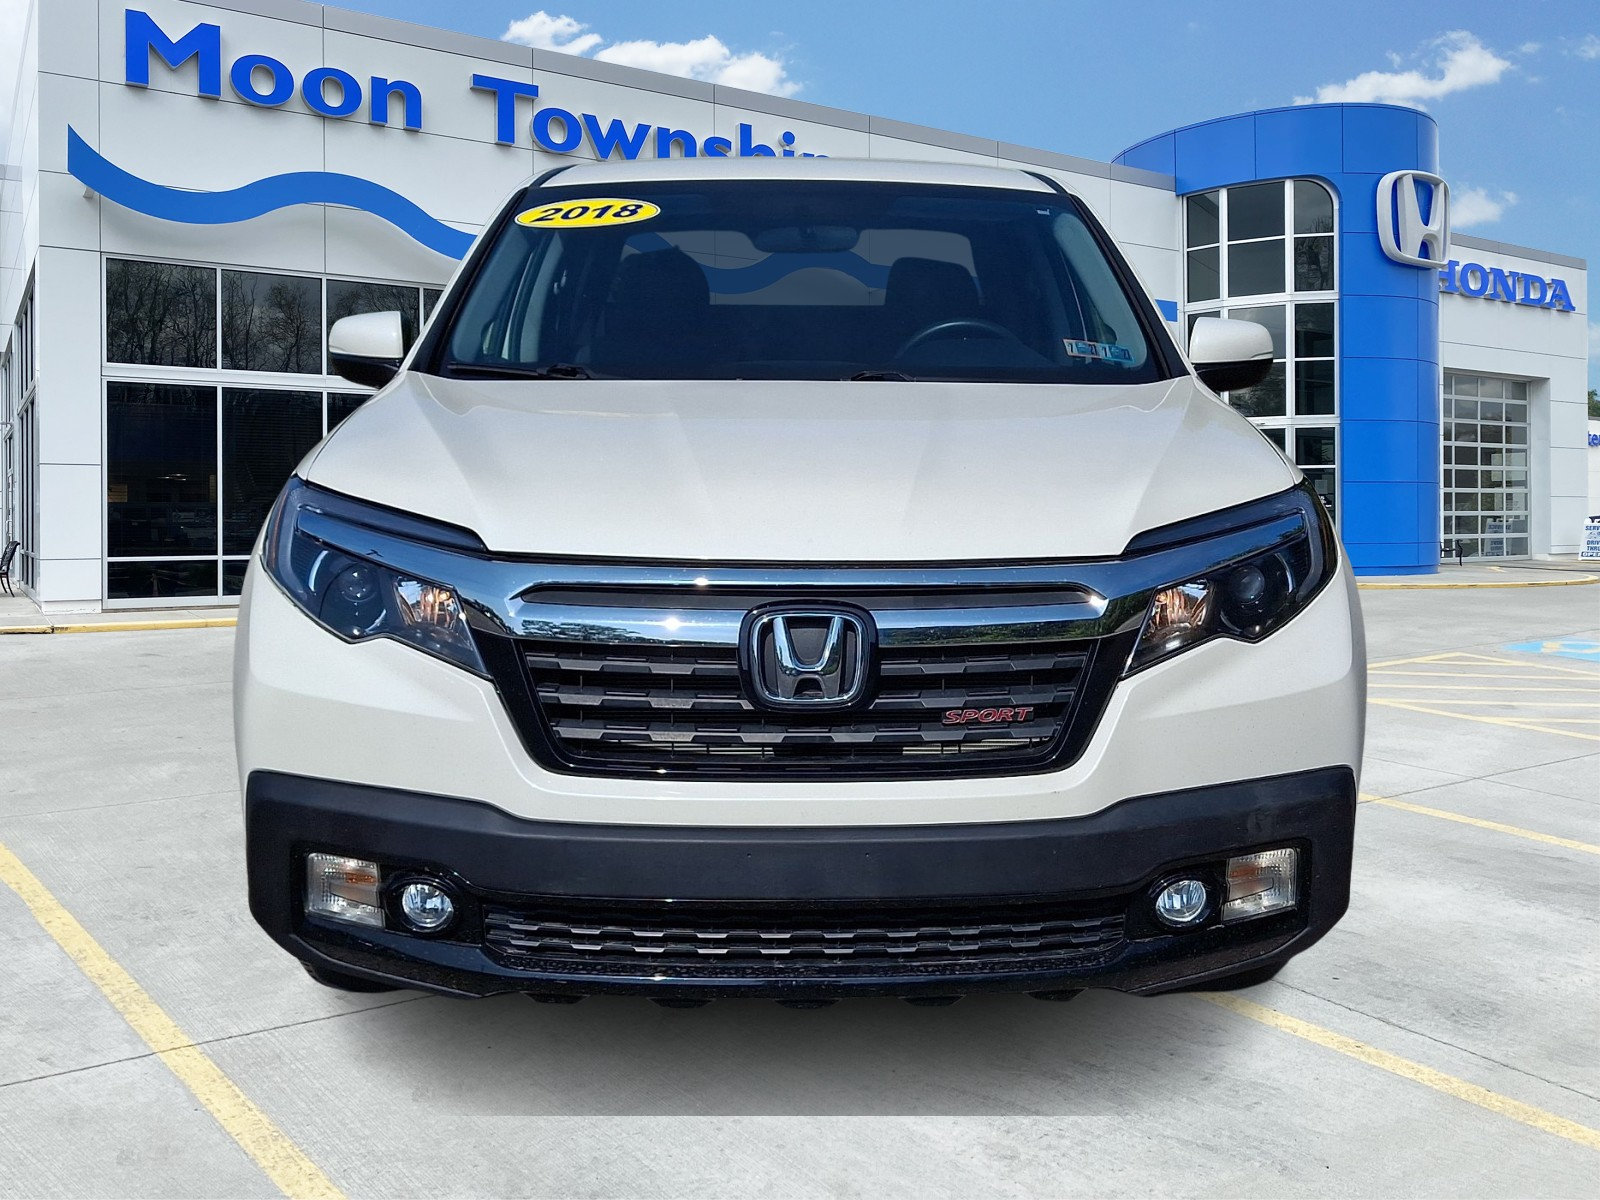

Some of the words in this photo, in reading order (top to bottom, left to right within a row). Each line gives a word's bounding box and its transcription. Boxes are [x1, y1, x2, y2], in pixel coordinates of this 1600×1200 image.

[125, 8, 422, 131] Moon
[470, 73, 831, 161] Townshi
[529, 203, 644, 223] 2018
[943, 706, 1034, 724] SPORT
